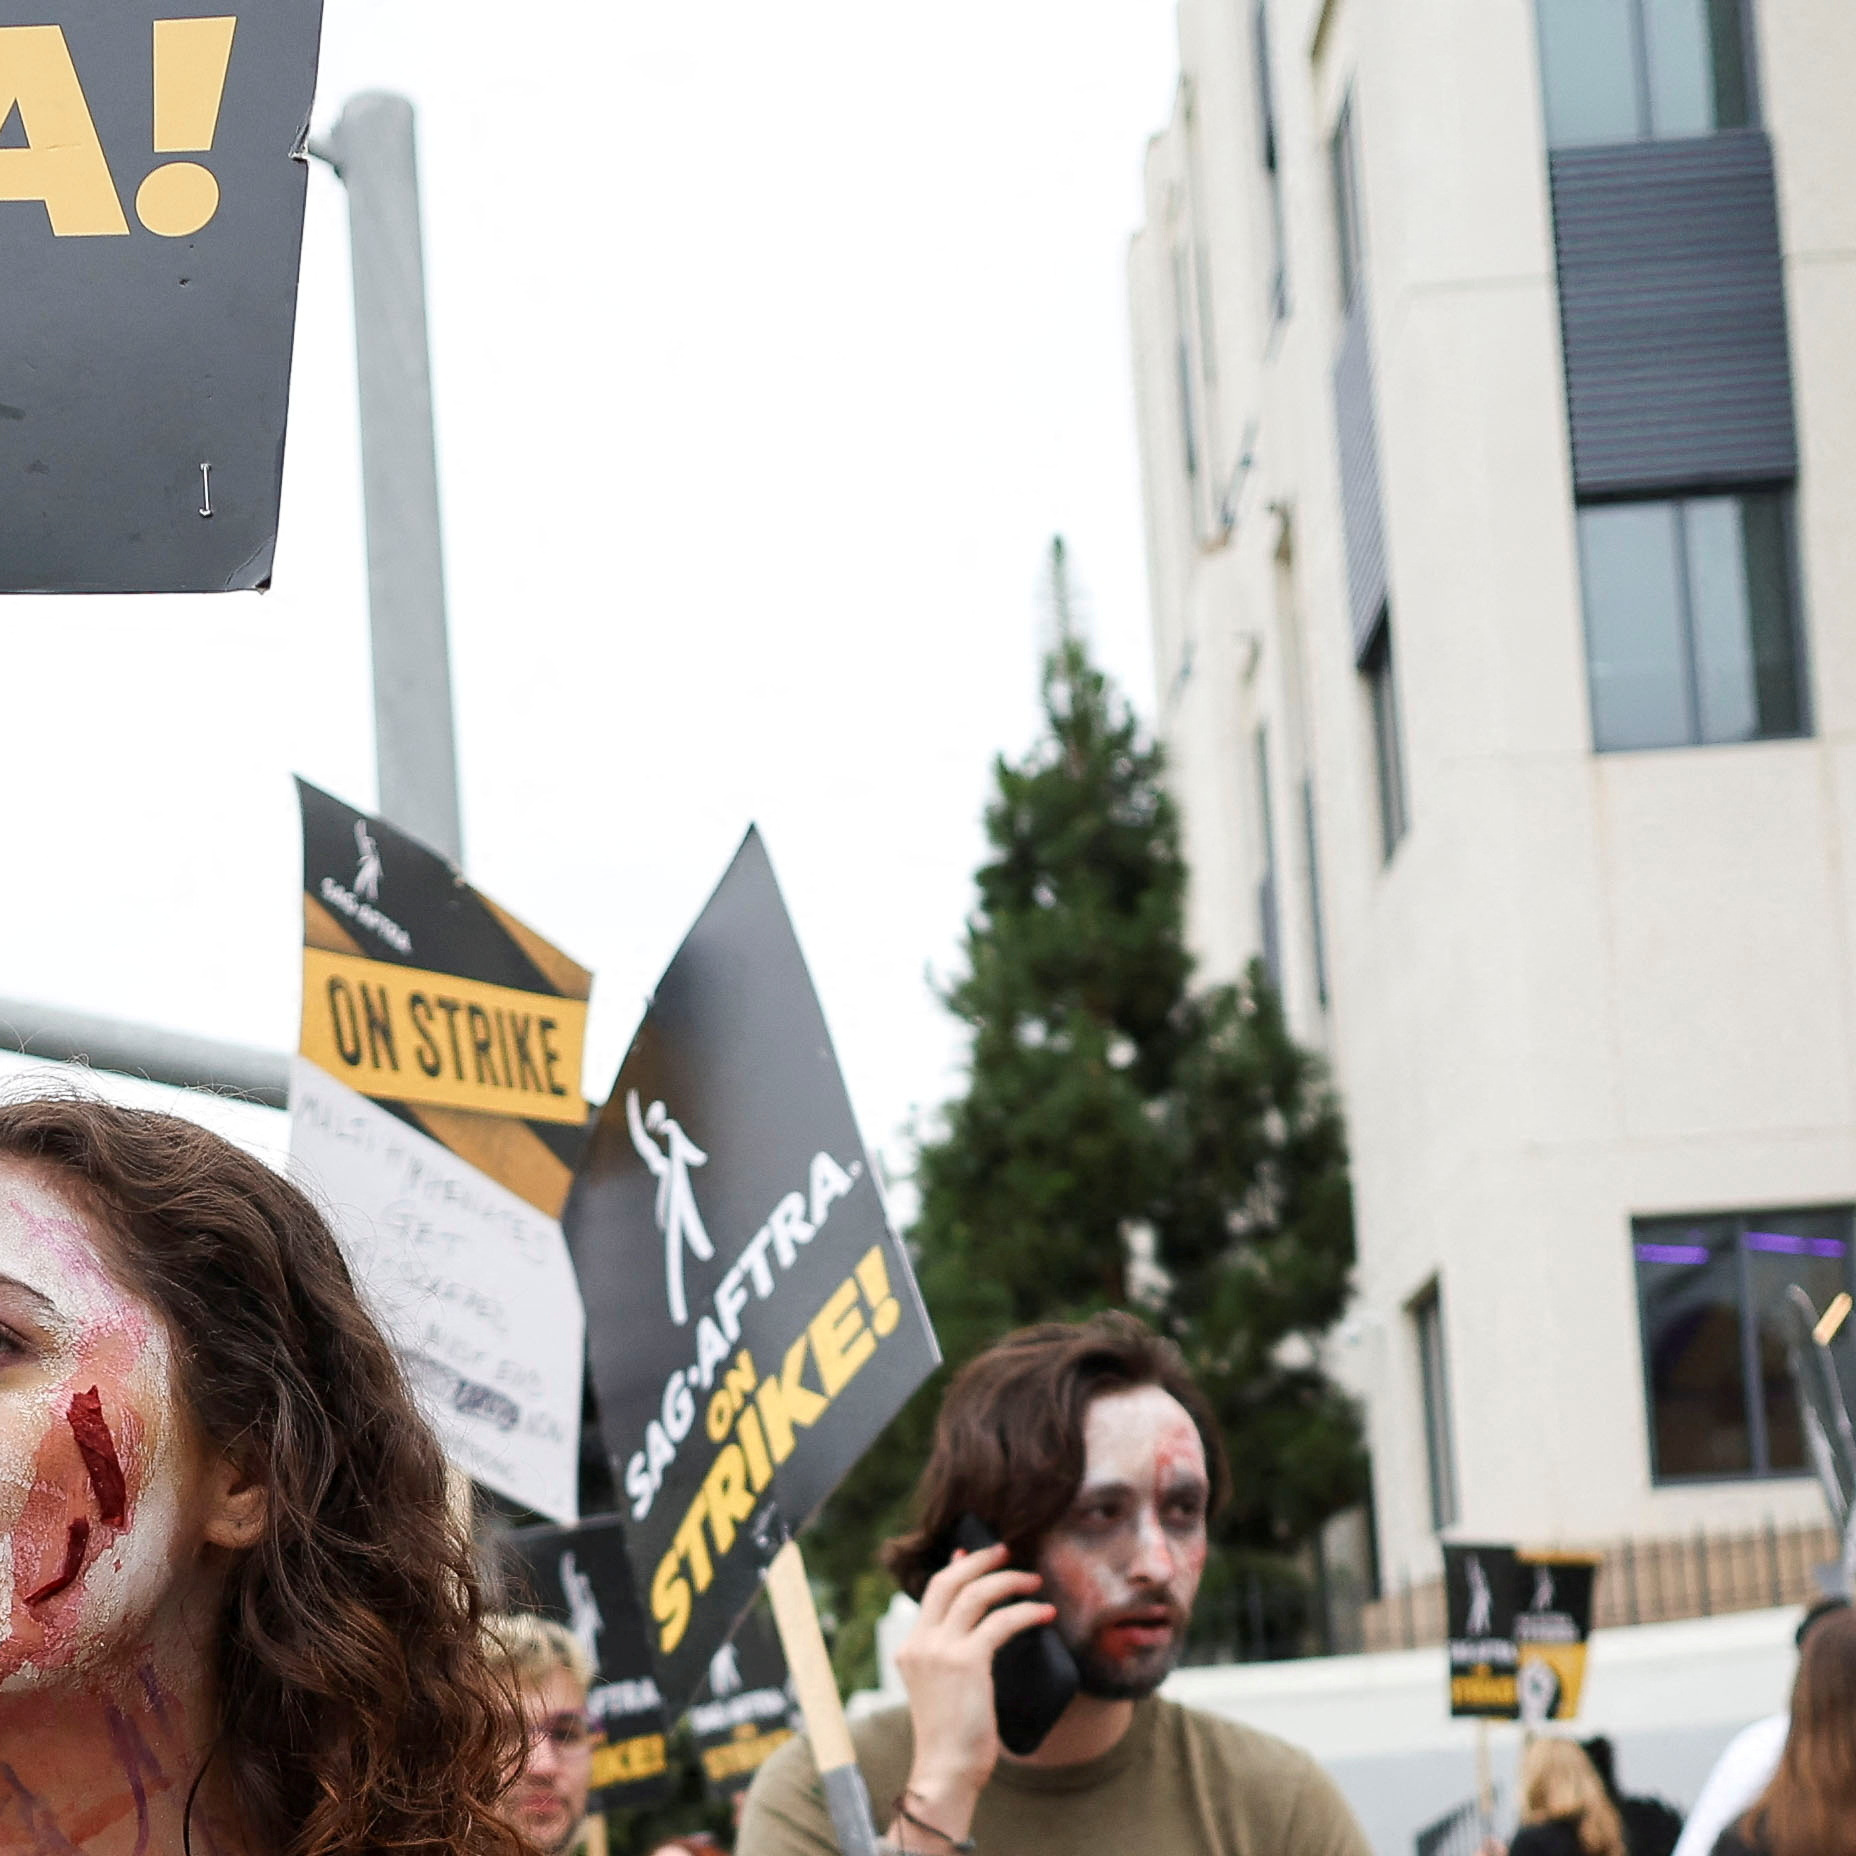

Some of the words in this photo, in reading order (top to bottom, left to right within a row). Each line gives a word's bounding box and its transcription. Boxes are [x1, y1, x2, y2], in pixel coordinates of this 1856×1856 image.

[328, 975, 400, 1071] ON
[408, 991, 568, 1096] STRIKE
[651, 1245, 901, 1655] STRIKE!
[706, 1348, 758, 1443] ON
